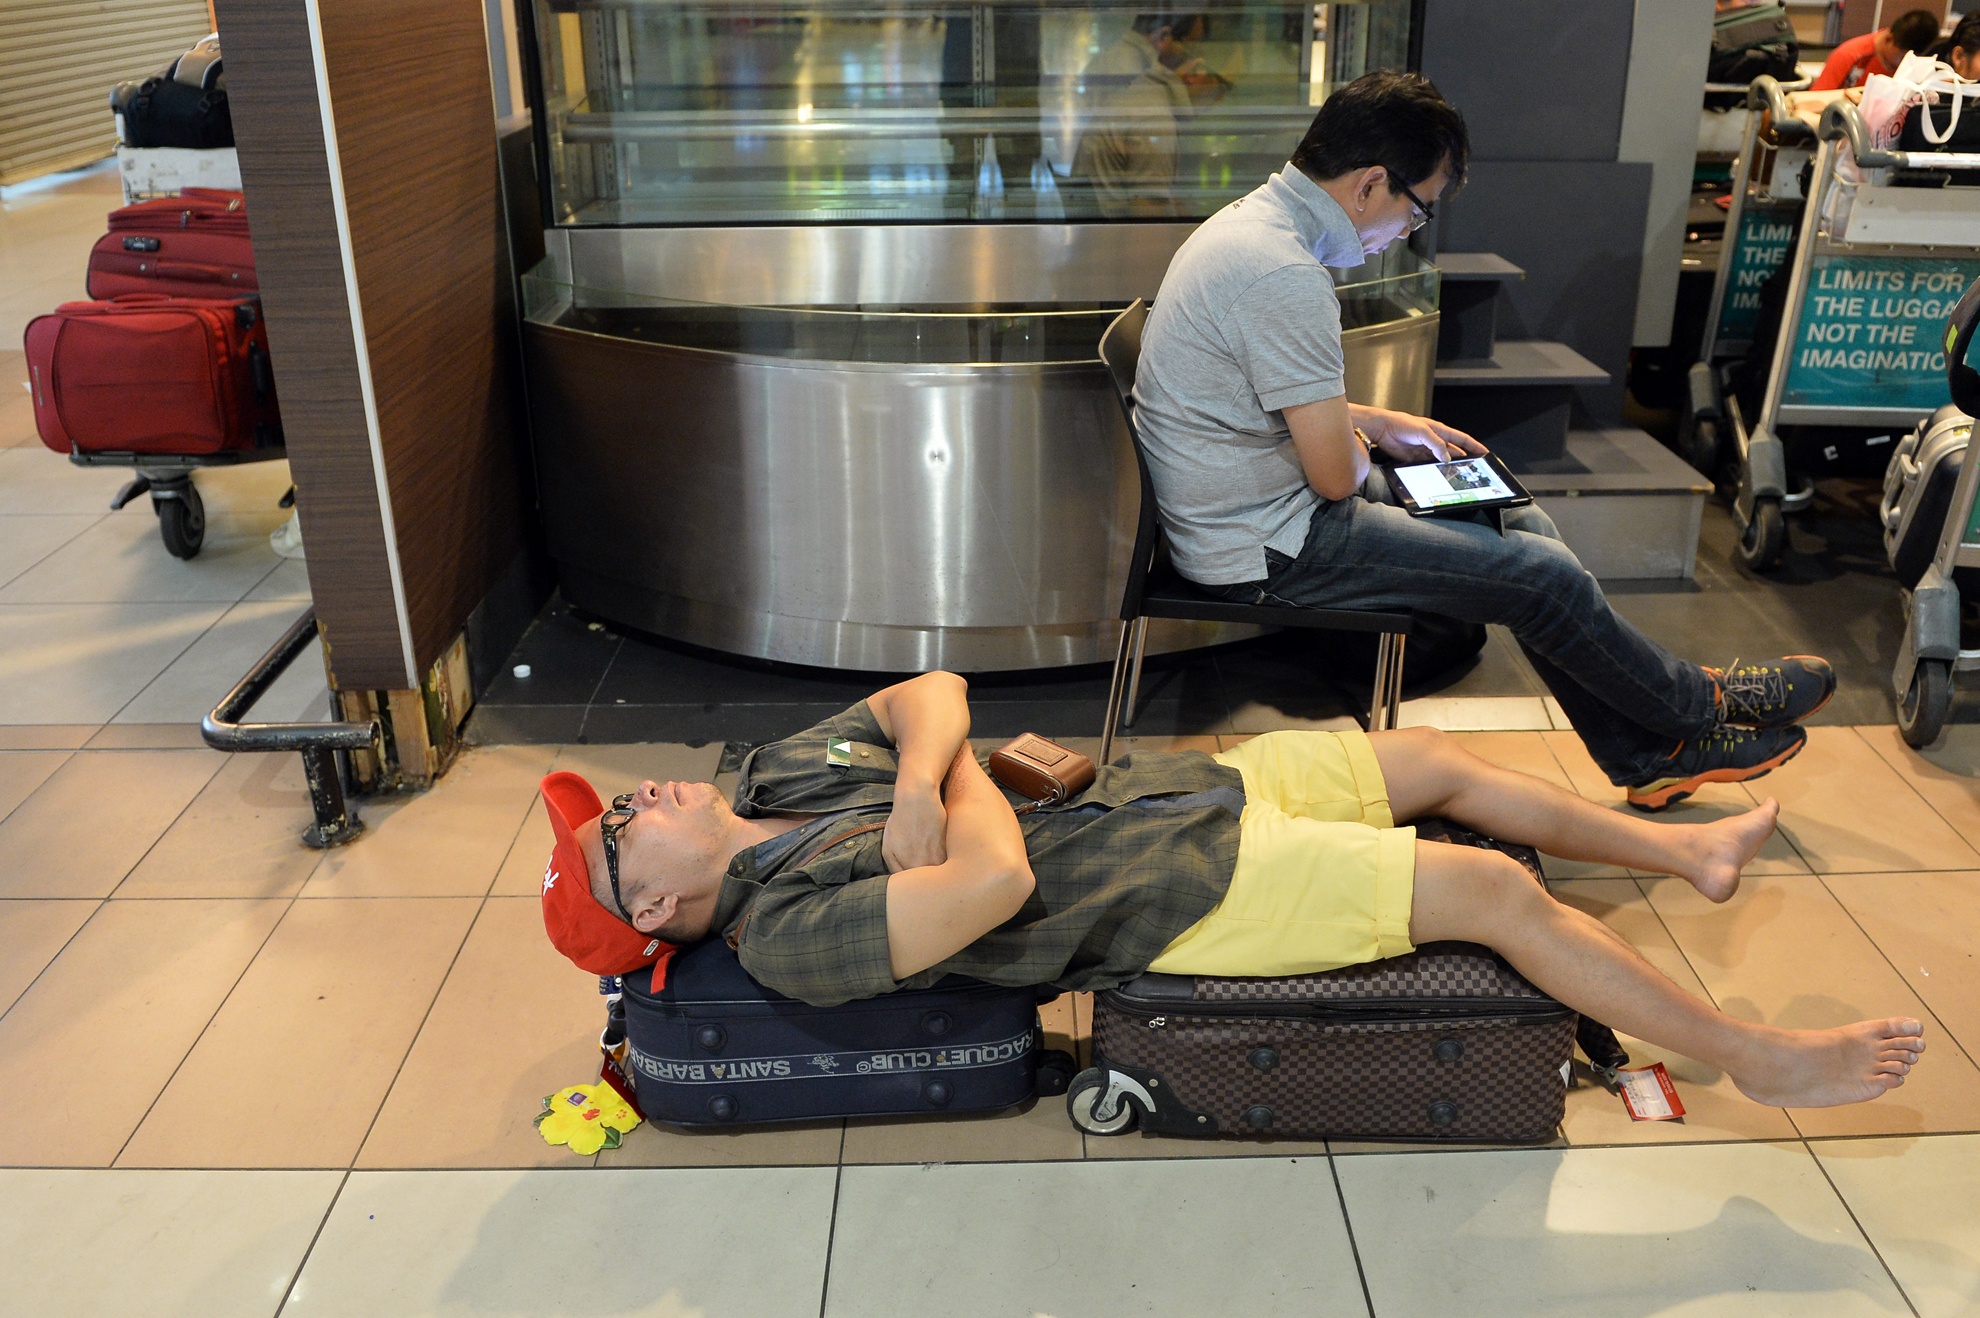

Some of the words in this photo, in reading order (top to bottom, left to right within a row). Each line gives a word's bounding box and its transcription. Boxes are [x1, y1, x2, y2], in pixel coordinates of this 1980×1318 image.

[1746, 223, 1797, 242] LIMI
[1743, 246, 1787, 265] THE
[1737, 268, 1775, 287] NO
[1818, 270, 1905, 292] LIMITS
[1910, 272, 1966, 293] FOR
[1814, 296, 1865, 318] THE
[1806, 323, 1863, 343] NOT
[1867, 324, 1917, 344] THE
[1800, 348, 1968, 371] IMAGINATIO
[935, 1028, 1034, 1067] RACQUET
[709, 1059, 791, 1080] SANTA
